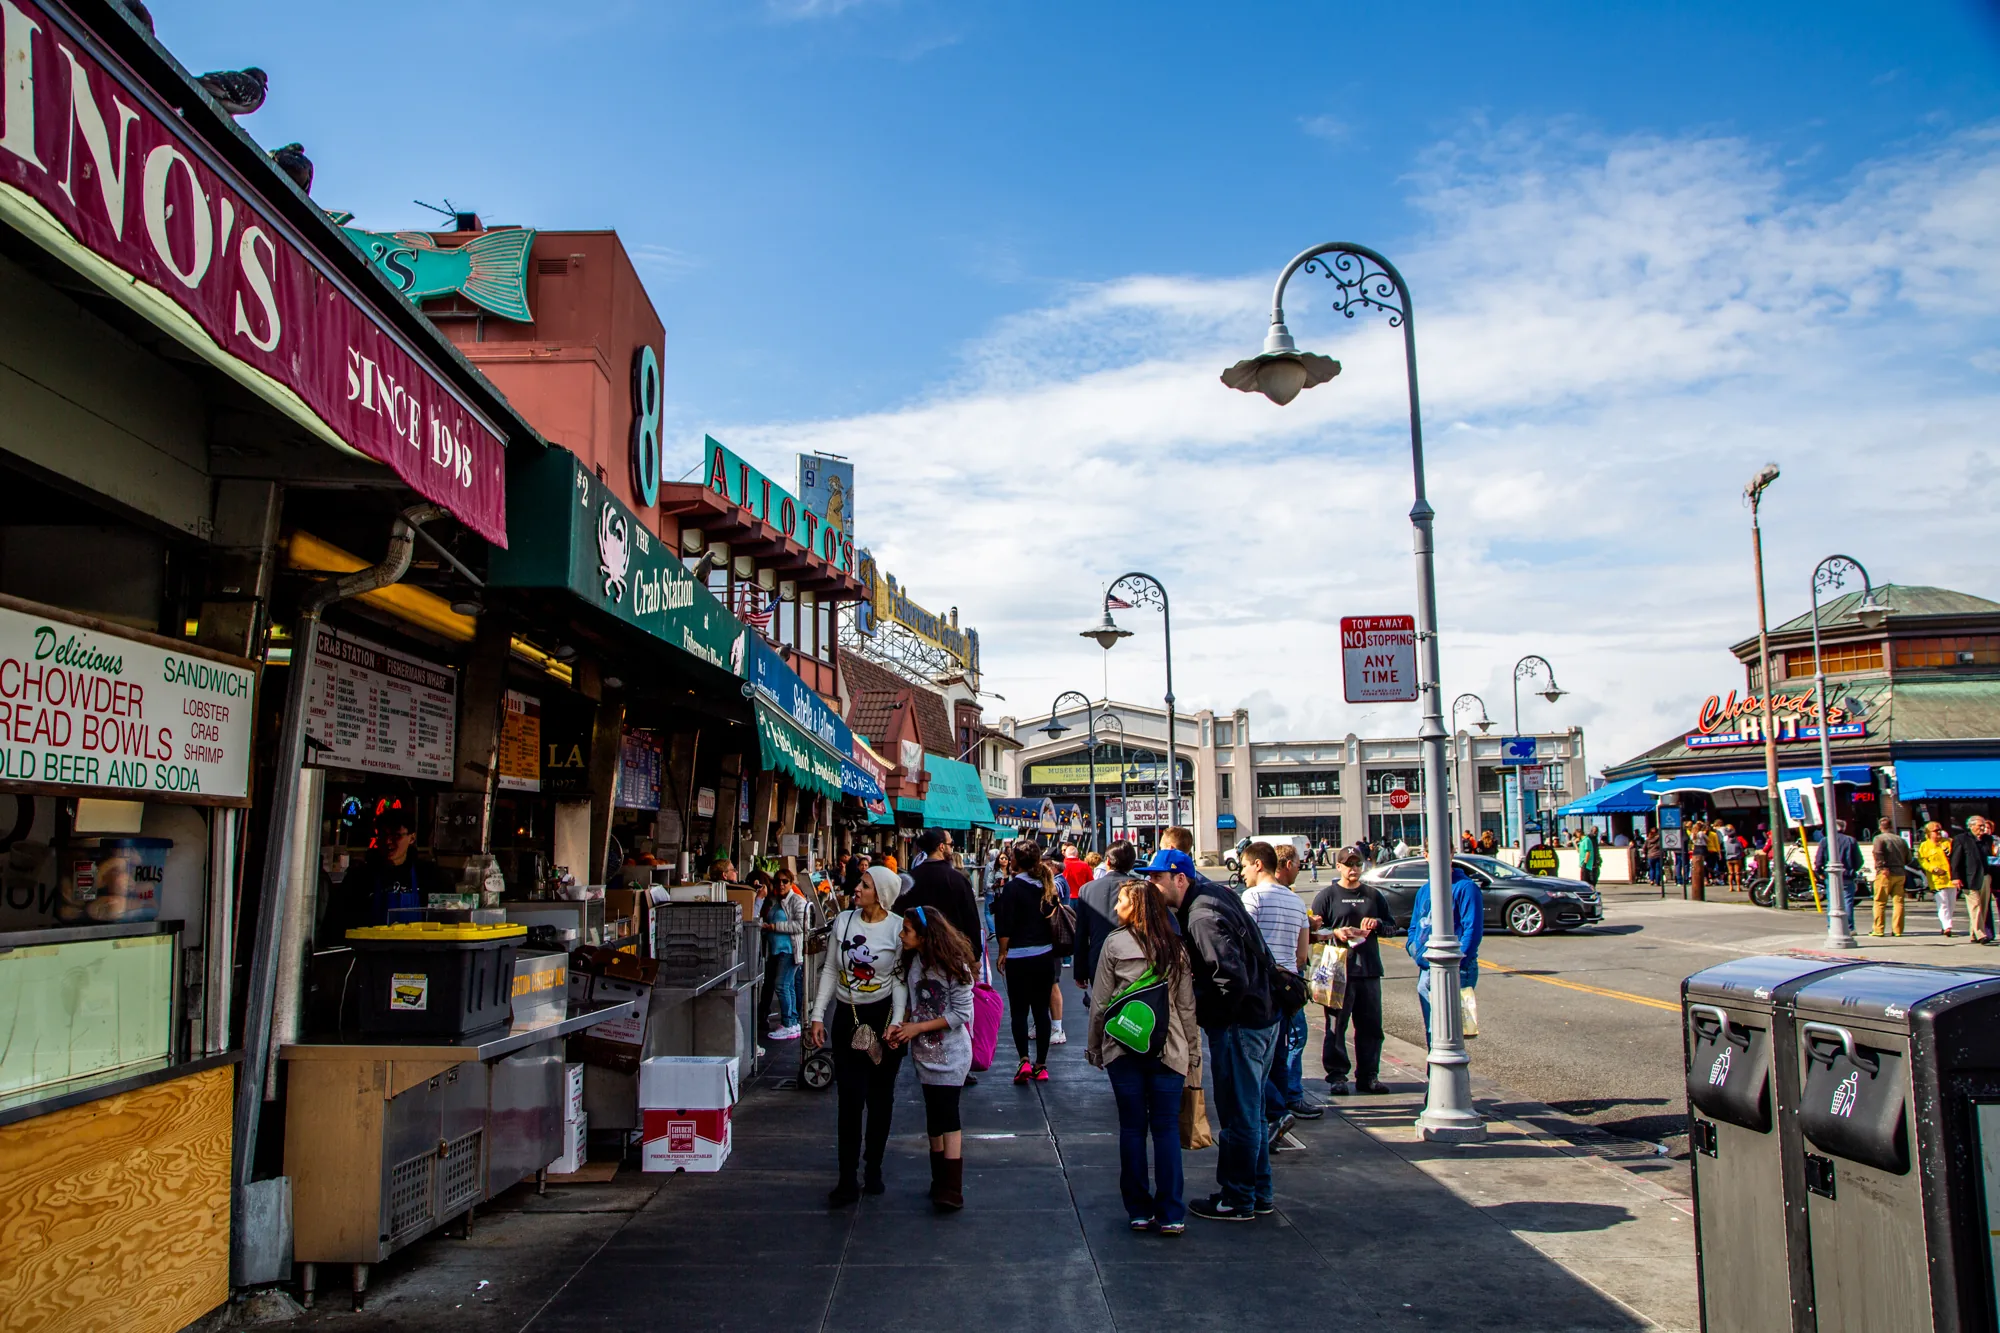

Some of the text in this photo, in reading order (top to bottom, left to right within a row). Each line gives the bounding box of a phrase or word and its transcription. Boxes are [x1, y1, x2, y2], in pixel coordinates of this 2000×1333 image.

[347, 345, 421, 451] SINCE
[633, 344, 660, 508] 8
[576, 471, 589, 509] #2
[804, 471, 815, 488] 9
[709, 447, 855, 577] ALIOTO'S
[635, 524, 650, 556] THE
[633, 567, 694, 617] Crab Station
[704, 612, 709, 630] at
[1352, 618, 1403, 629] TOW-AWAY
[34, 624, 124, 676] Delicious
[1343, 631, 1413, 647] NO STOPPING
[317, 633, 341, 656] CRAB
[341, 642, 376, 670] STATION
[386, 658, 426, 684] FISHERMANS
[426, 671, 448, 690] WHARF
[1364, 654, 1395, 668] ANY
[0, 658, 144, 719] CHOWDER
[163, 656, 249, 699] SANDWICH
[1362, 670, 1399, 684] TIME
[182, 698, 230, 724] LOBSTER
[793, 683, 812, 731] Sabella
[82, 713, 173, 763] BOWLS
[190, 723, 220, 743] CRAB
[1690, 713, 1859, 745] FRESH HUT GILL
[183, 743, 224, 765] SHRIMP
[361, 759, 368, 767] WE
[368, 761, 378, 769] PACK
[44, 752, 99, 785] BEER
[107, 758, 150, 788] AND
[155, 758, 201, 792] SODA
[1391, 794, 1409, 804] STOP
[1529, 859, 1556, 868] PARKING
[1531, 850, 1553, 859] PUBLIC
[135, 865, 163, 883] ROLLS
[671, 1126, 693, 1134] CHURCH
